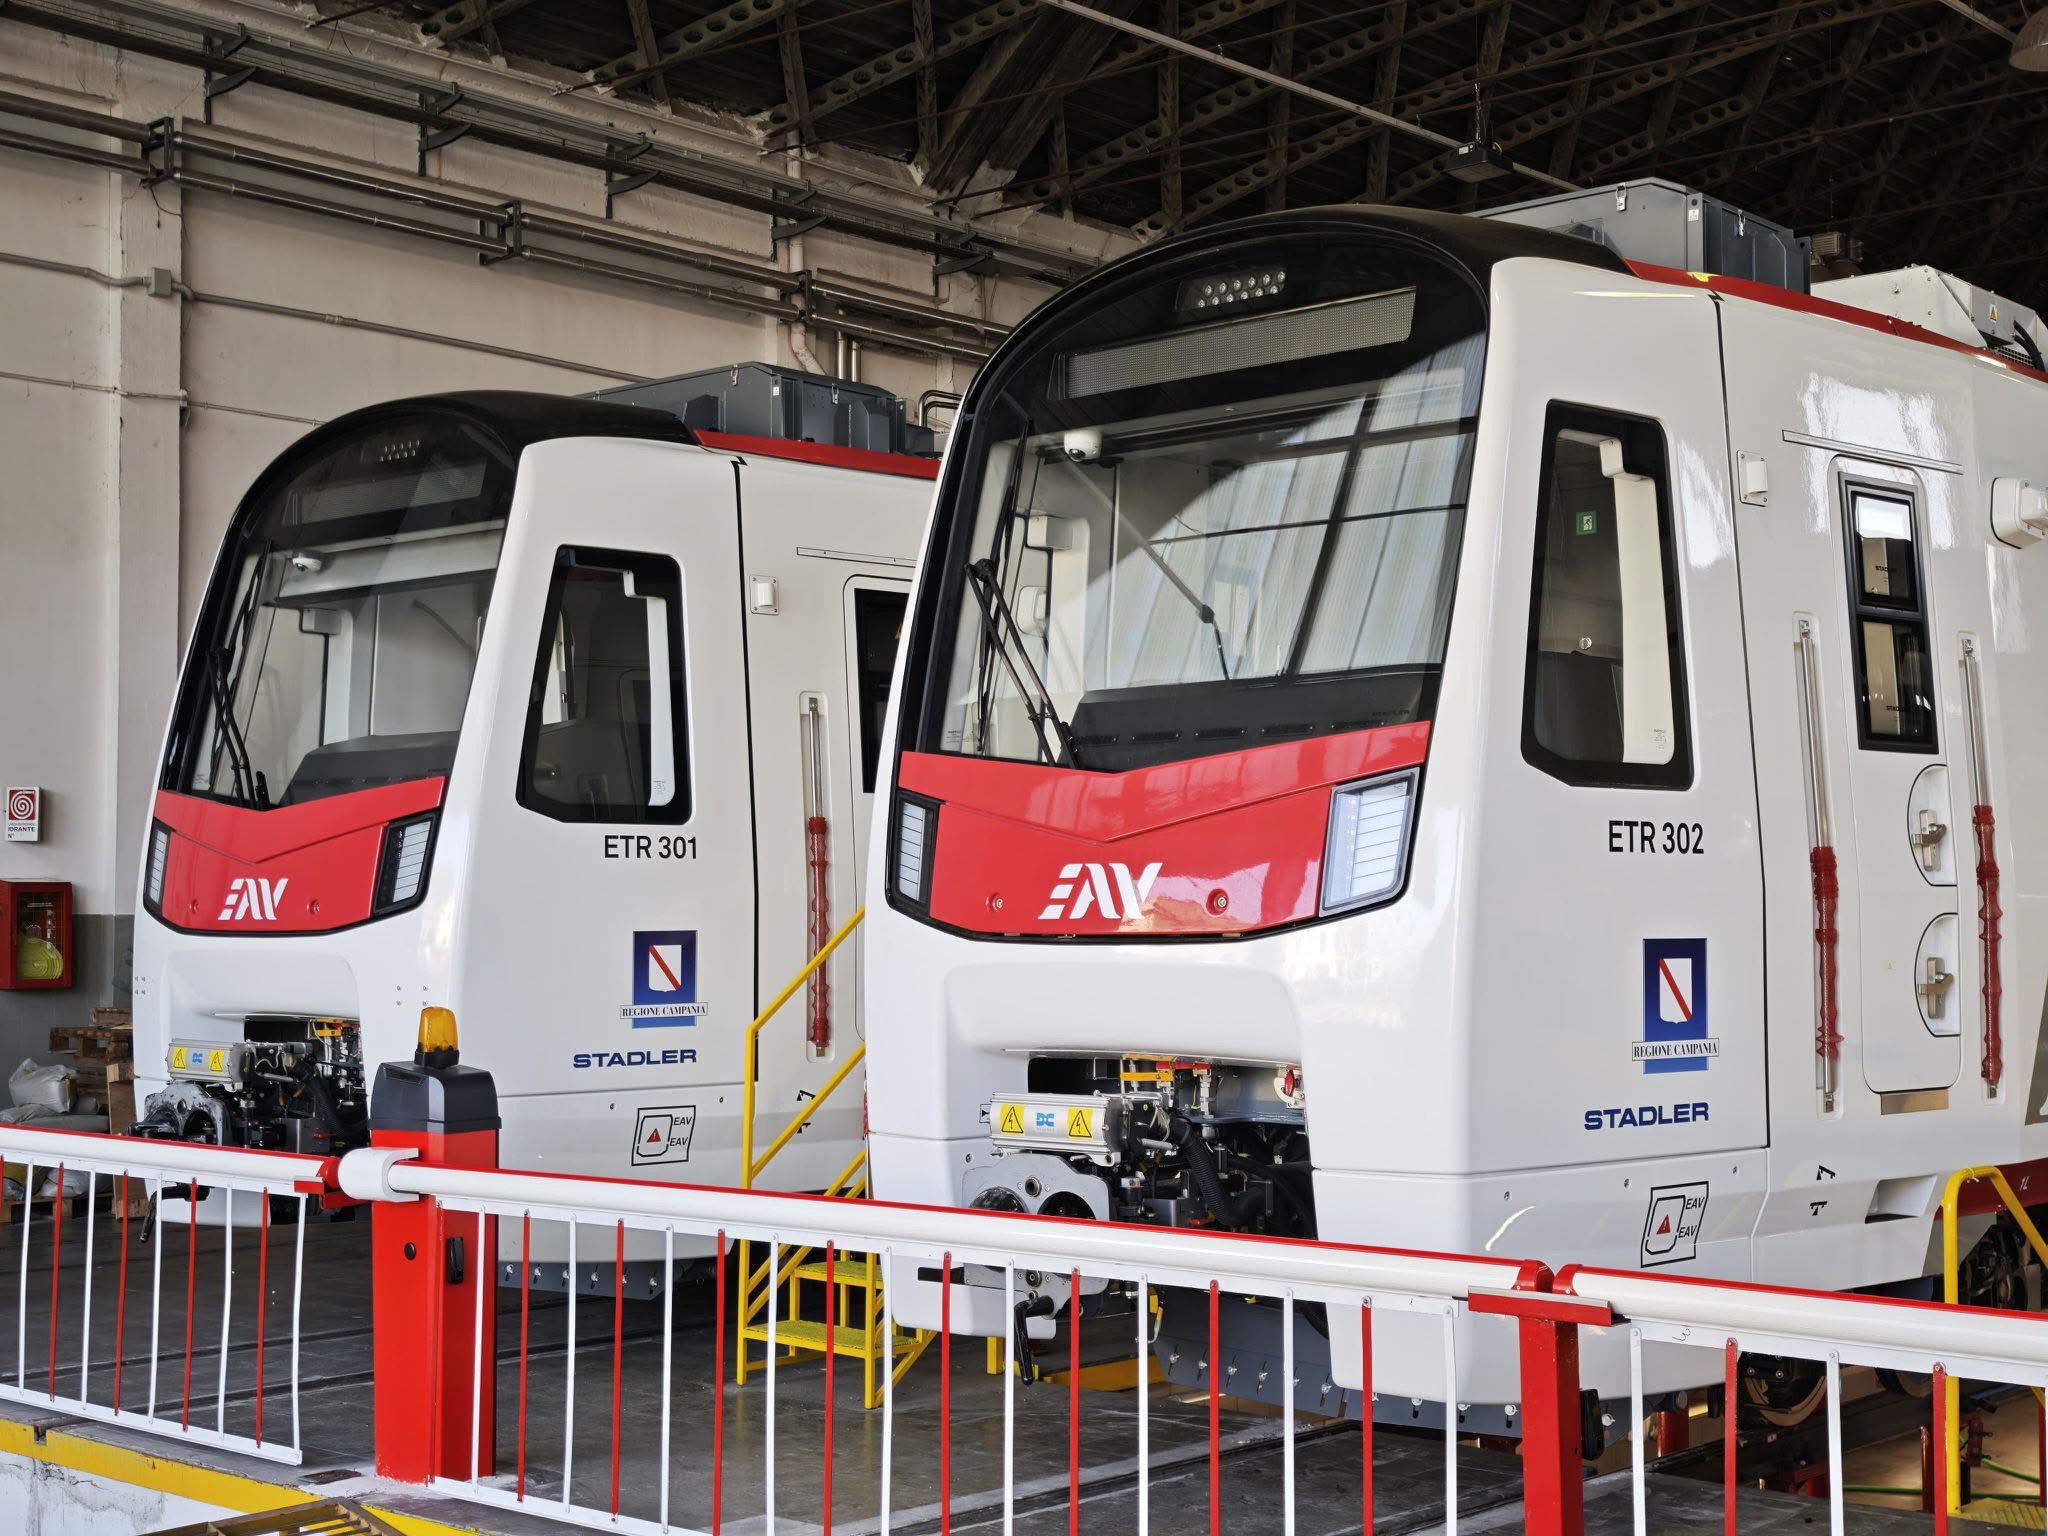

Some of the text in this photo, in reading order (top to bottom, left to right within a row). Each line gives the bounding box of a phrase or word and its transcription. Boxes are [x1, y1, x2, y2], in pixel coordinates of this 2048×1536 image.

[604, 835, 698, 859] ETR 301
[1608, 821, 1705, 855] ETR 302
[217, 878, 289, 921] EAV
[1037, 862, 1164, 920] EAV
[622, 1005, 706, 1017] REGIONE CAMPANIA
[573, 1049, 697, 1069] STADLER
[1634, 1042, 1718, 1058] REGIONE CAMPANIA
[673, 1116, 692, 1126] EAV
[1584, 1102, 1709, 1131] STADLER
[669, 1137, 688, 1147] EAV
[1685, 1196, 1705, 1210] EAV
[1678, 1225, 1698, 1239] EAV
